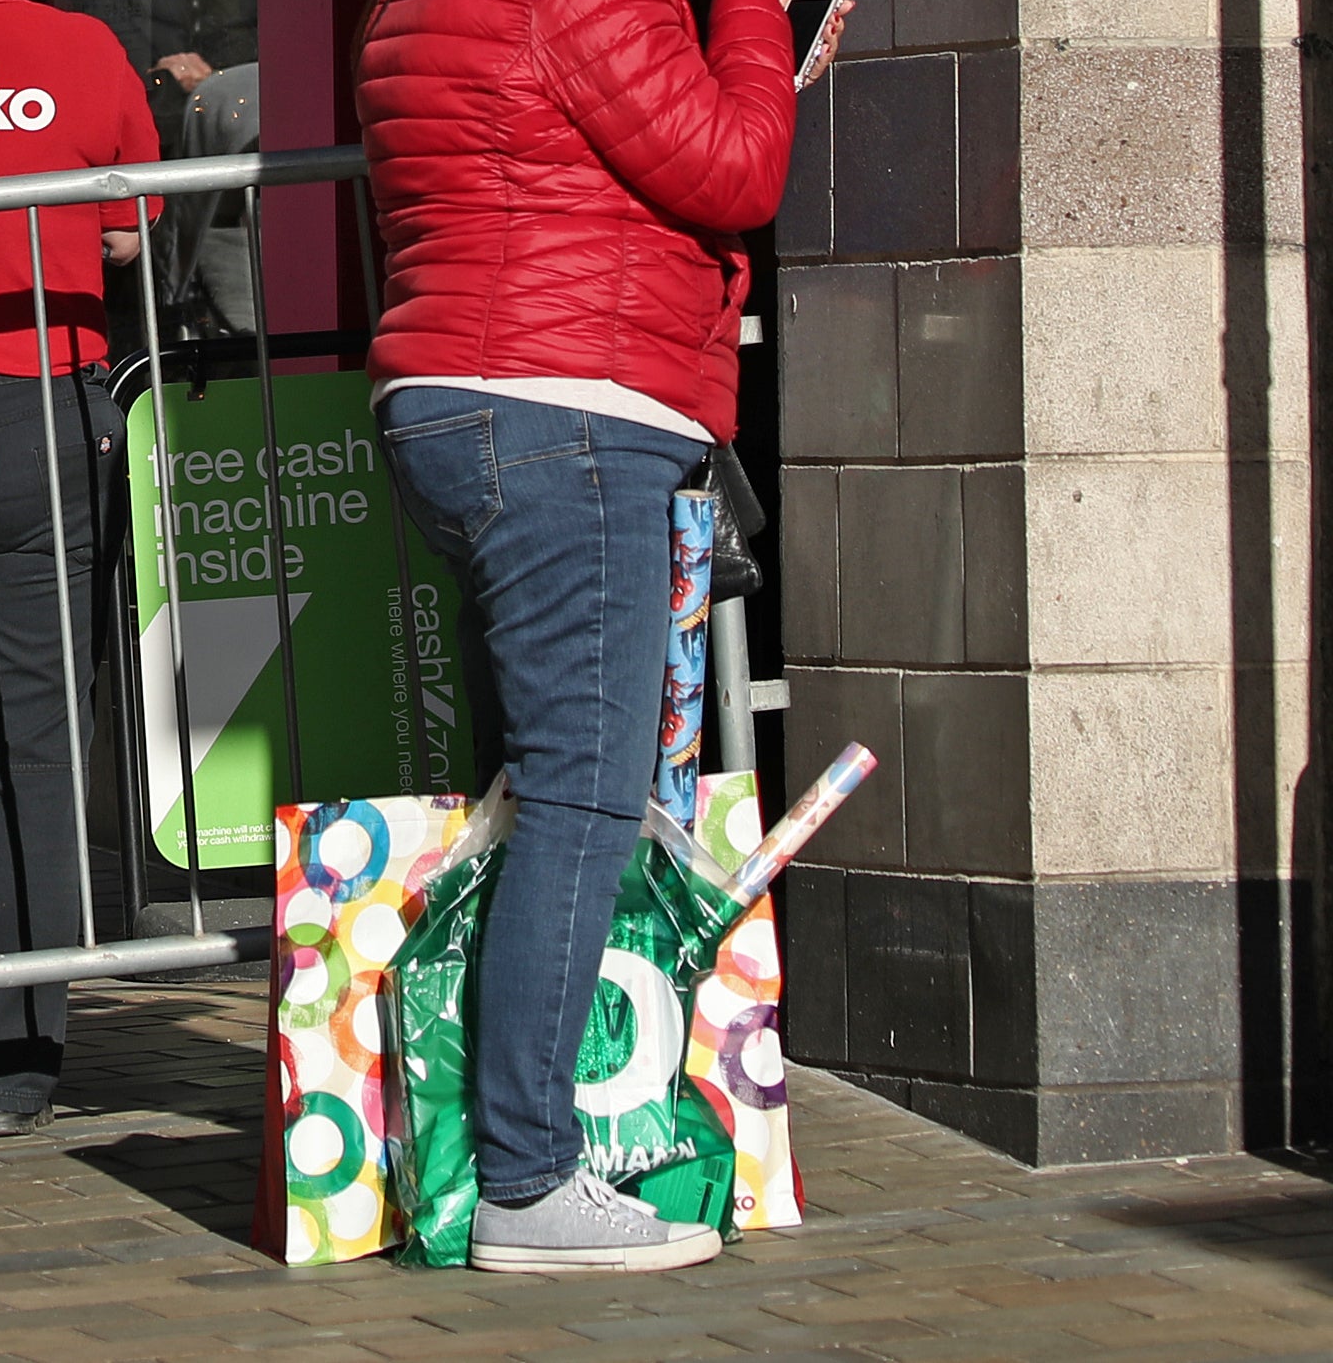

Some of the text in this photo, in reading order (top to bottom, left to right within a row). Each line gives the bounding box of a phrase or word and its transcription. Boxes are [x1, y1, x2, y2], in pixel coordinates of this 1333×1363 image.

[148, 429, 374, 488] free cash
[153, 483, 369, 537] machine
[157, 535, 304, 587] inside
[387, 586, 404, 637] there
[411, 583, 451, 683] cash
[390, 642, 410, 703] where
[390, 709, 411, 745] you
[196, 826, 232, 838] machine
[233, 824, 248, 835] will
[249, 823, 264, 833] not
[196, 837, 208, 846] for
[209, 835, 231, 845] cash
[589, 1136, 698, 1173] MANN
